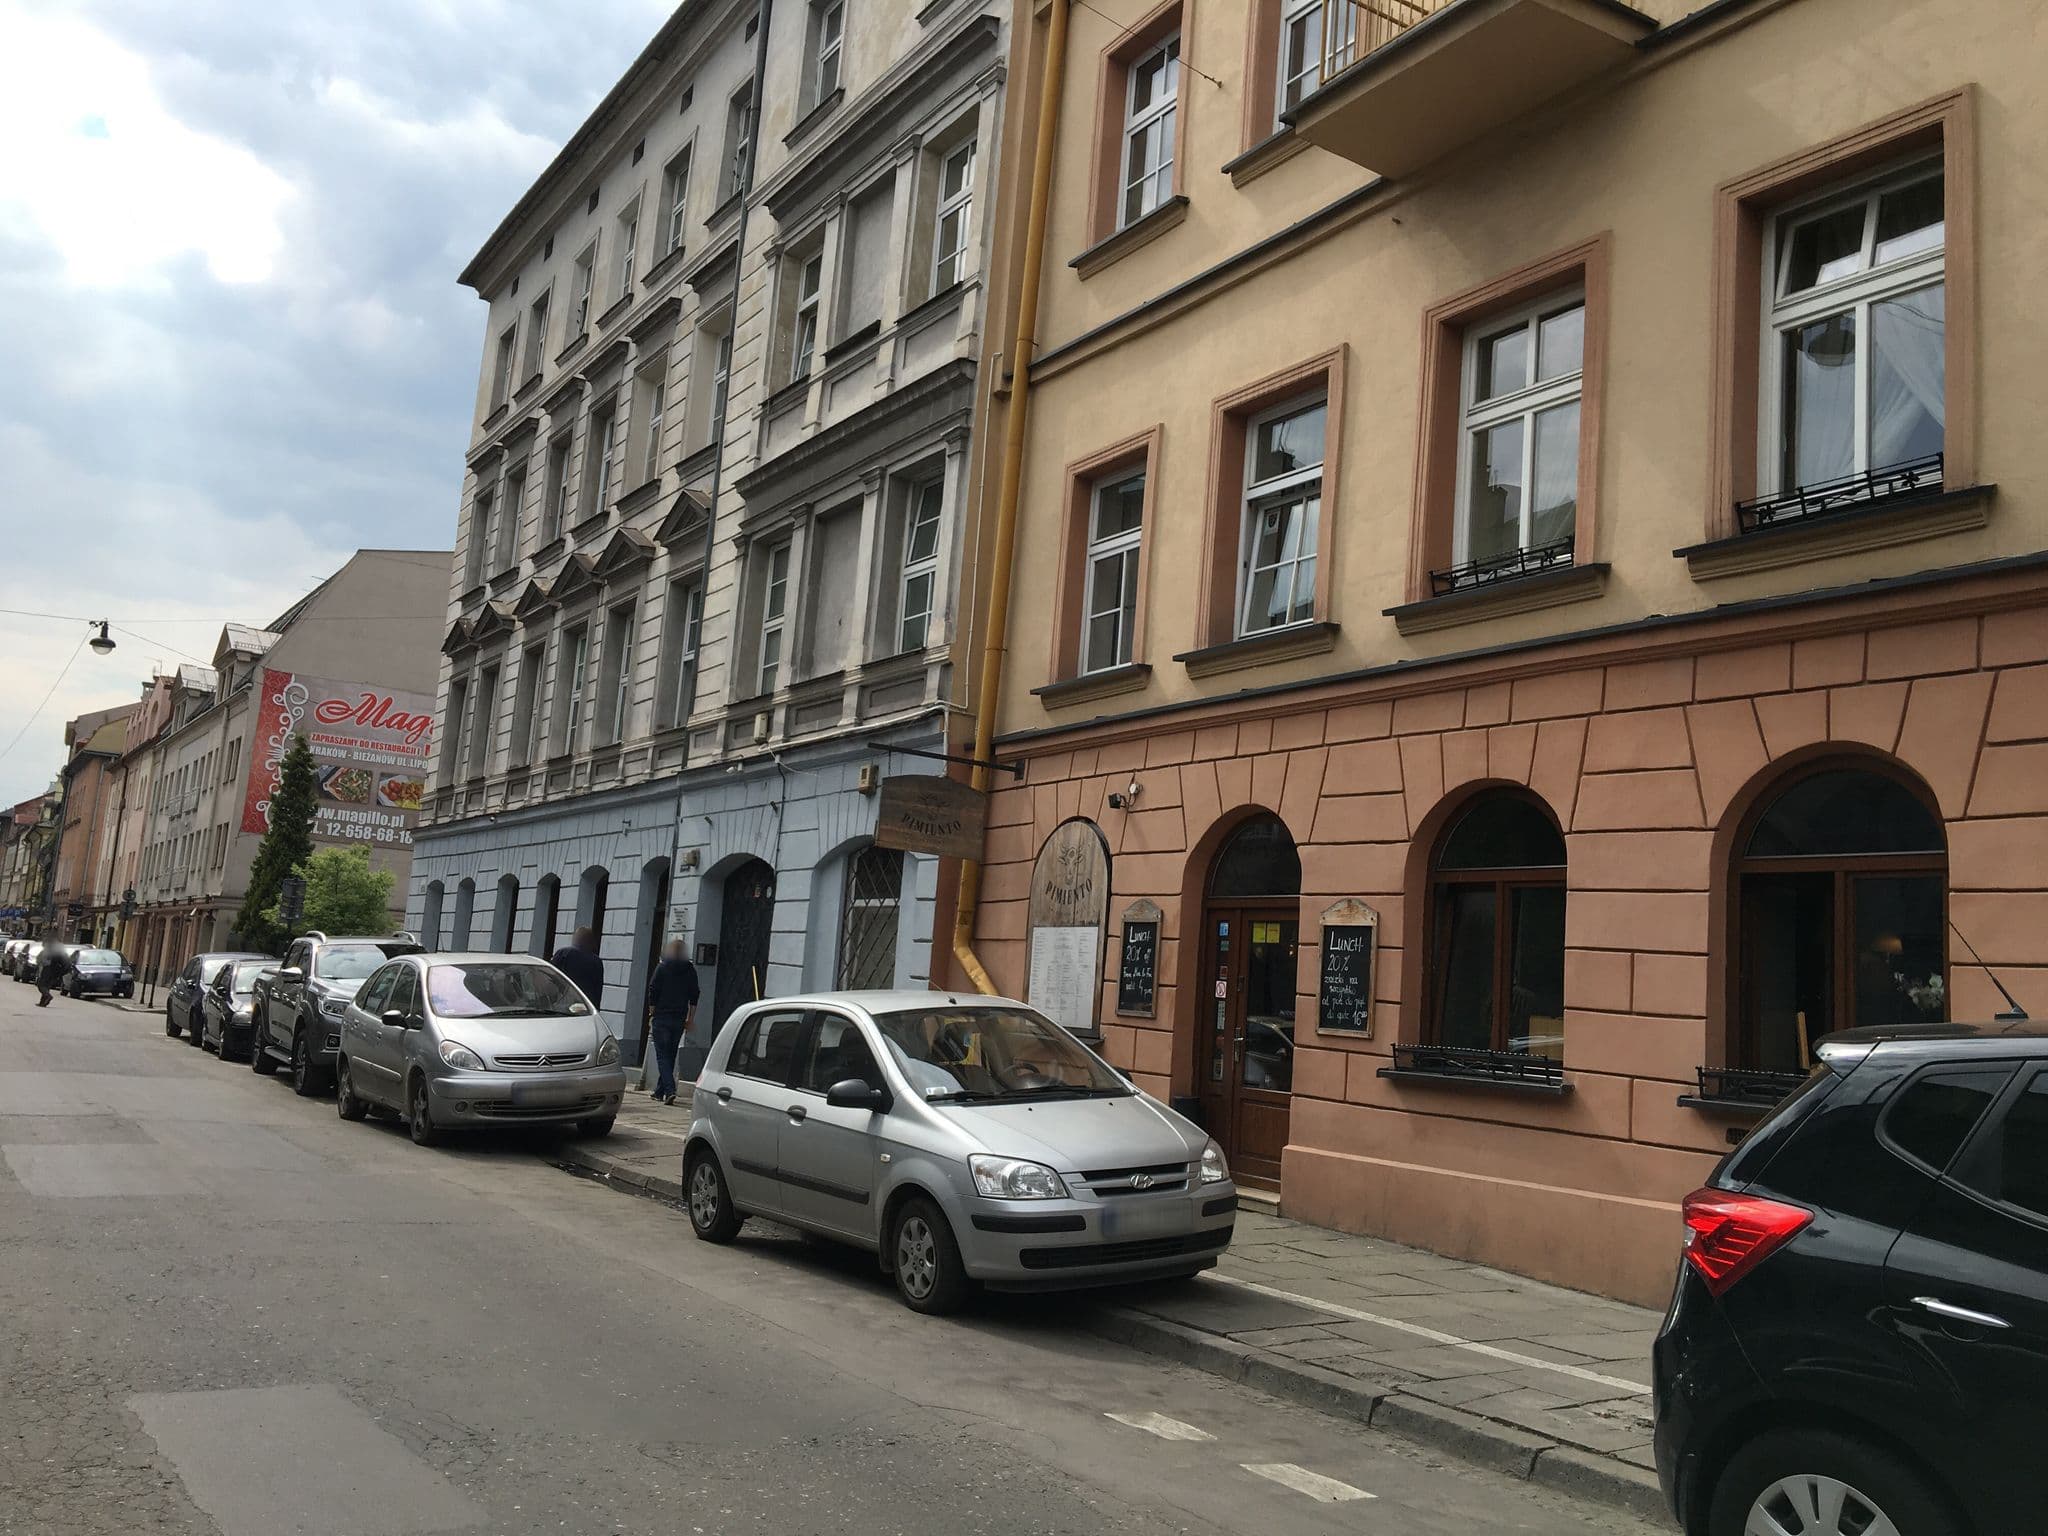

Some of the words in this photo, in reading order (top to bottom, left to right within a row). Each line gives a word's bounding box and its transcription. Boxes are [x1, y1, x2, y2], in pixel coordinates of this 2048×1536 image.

[315, 807, 405, 828] ww.magillo.pl
[1045, 878, 1093, 905] PIMIENTO
[1327, 954, 1352, 972] 20%
